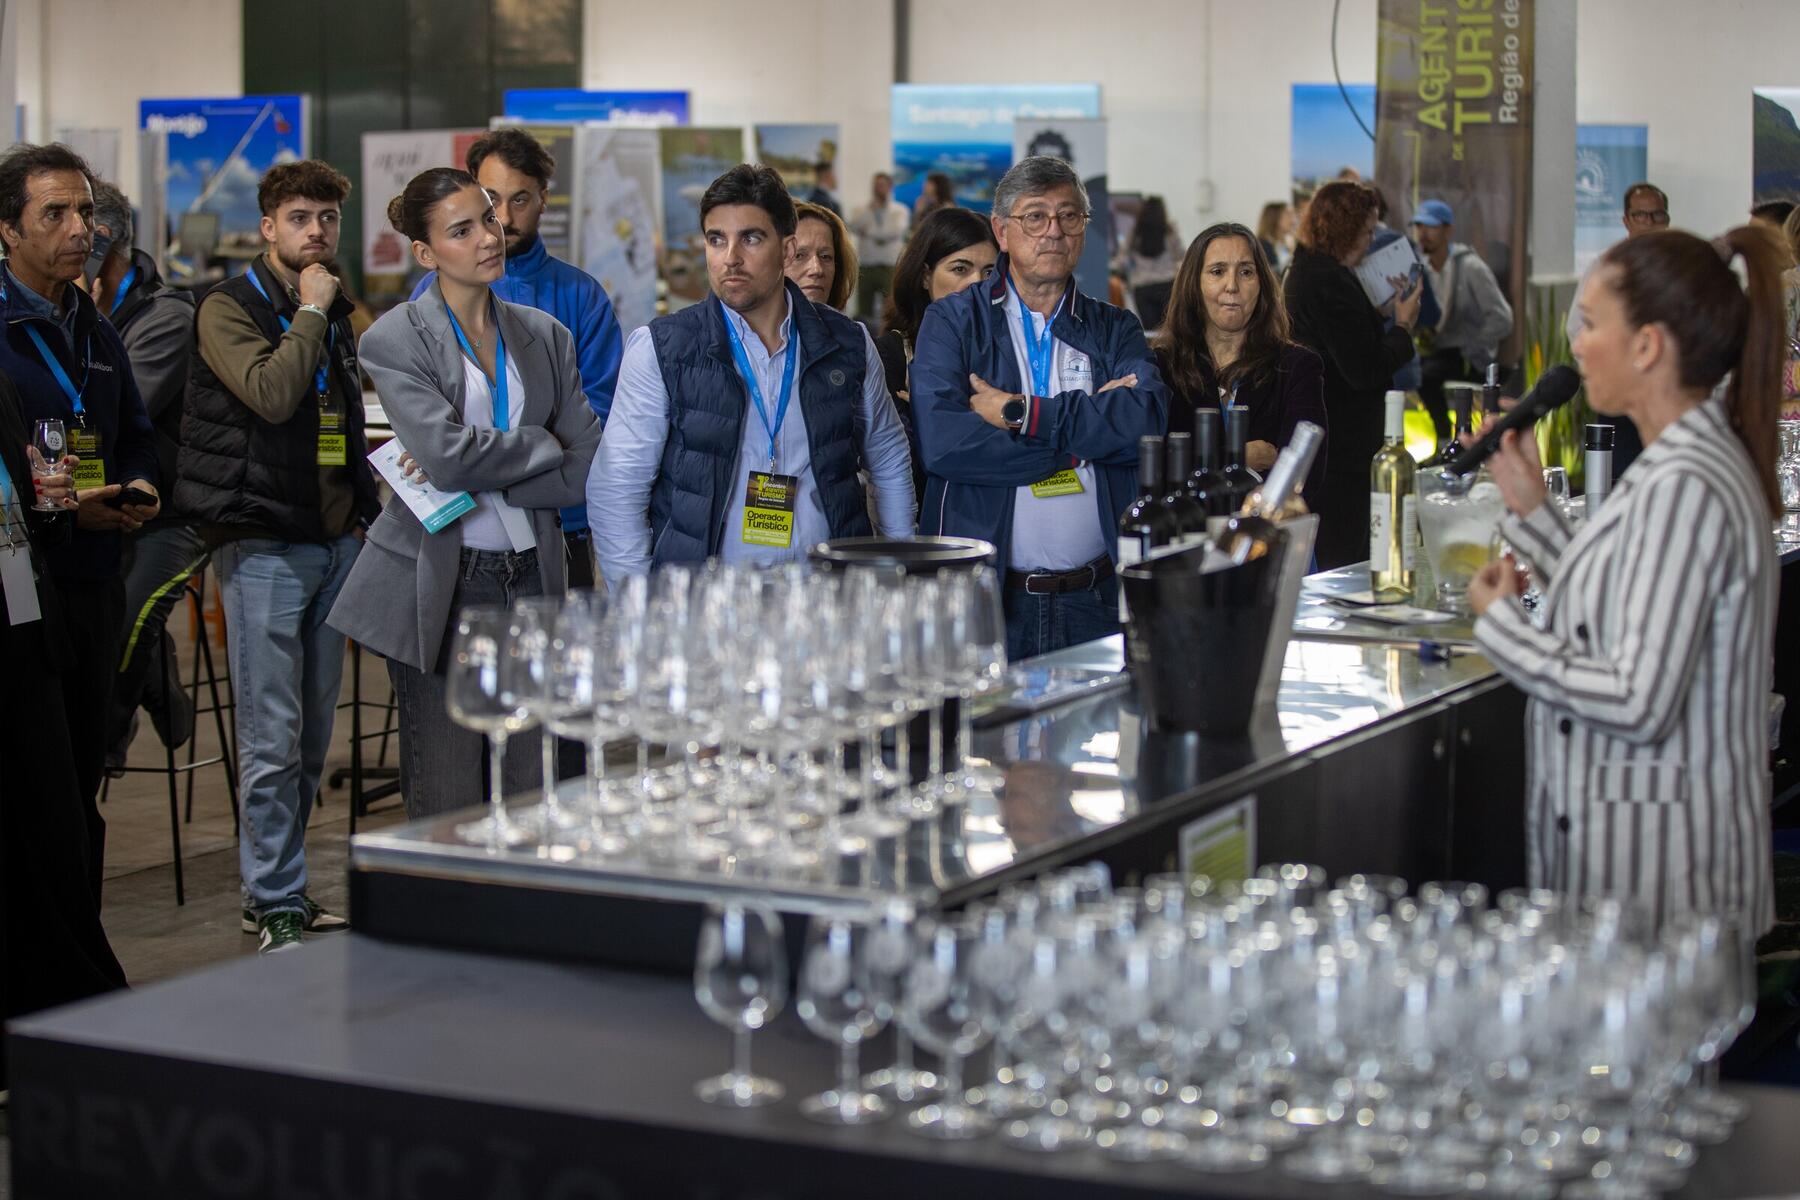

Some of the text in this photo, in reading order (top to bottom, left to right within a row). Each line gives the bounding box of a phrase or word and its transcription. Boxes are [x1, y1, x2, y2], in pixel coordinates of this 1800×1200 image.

[1499, 34, 1525, 124] Região
[747, 510, 786, 522] Operador
[747, 519, 788, 531] Turístico
